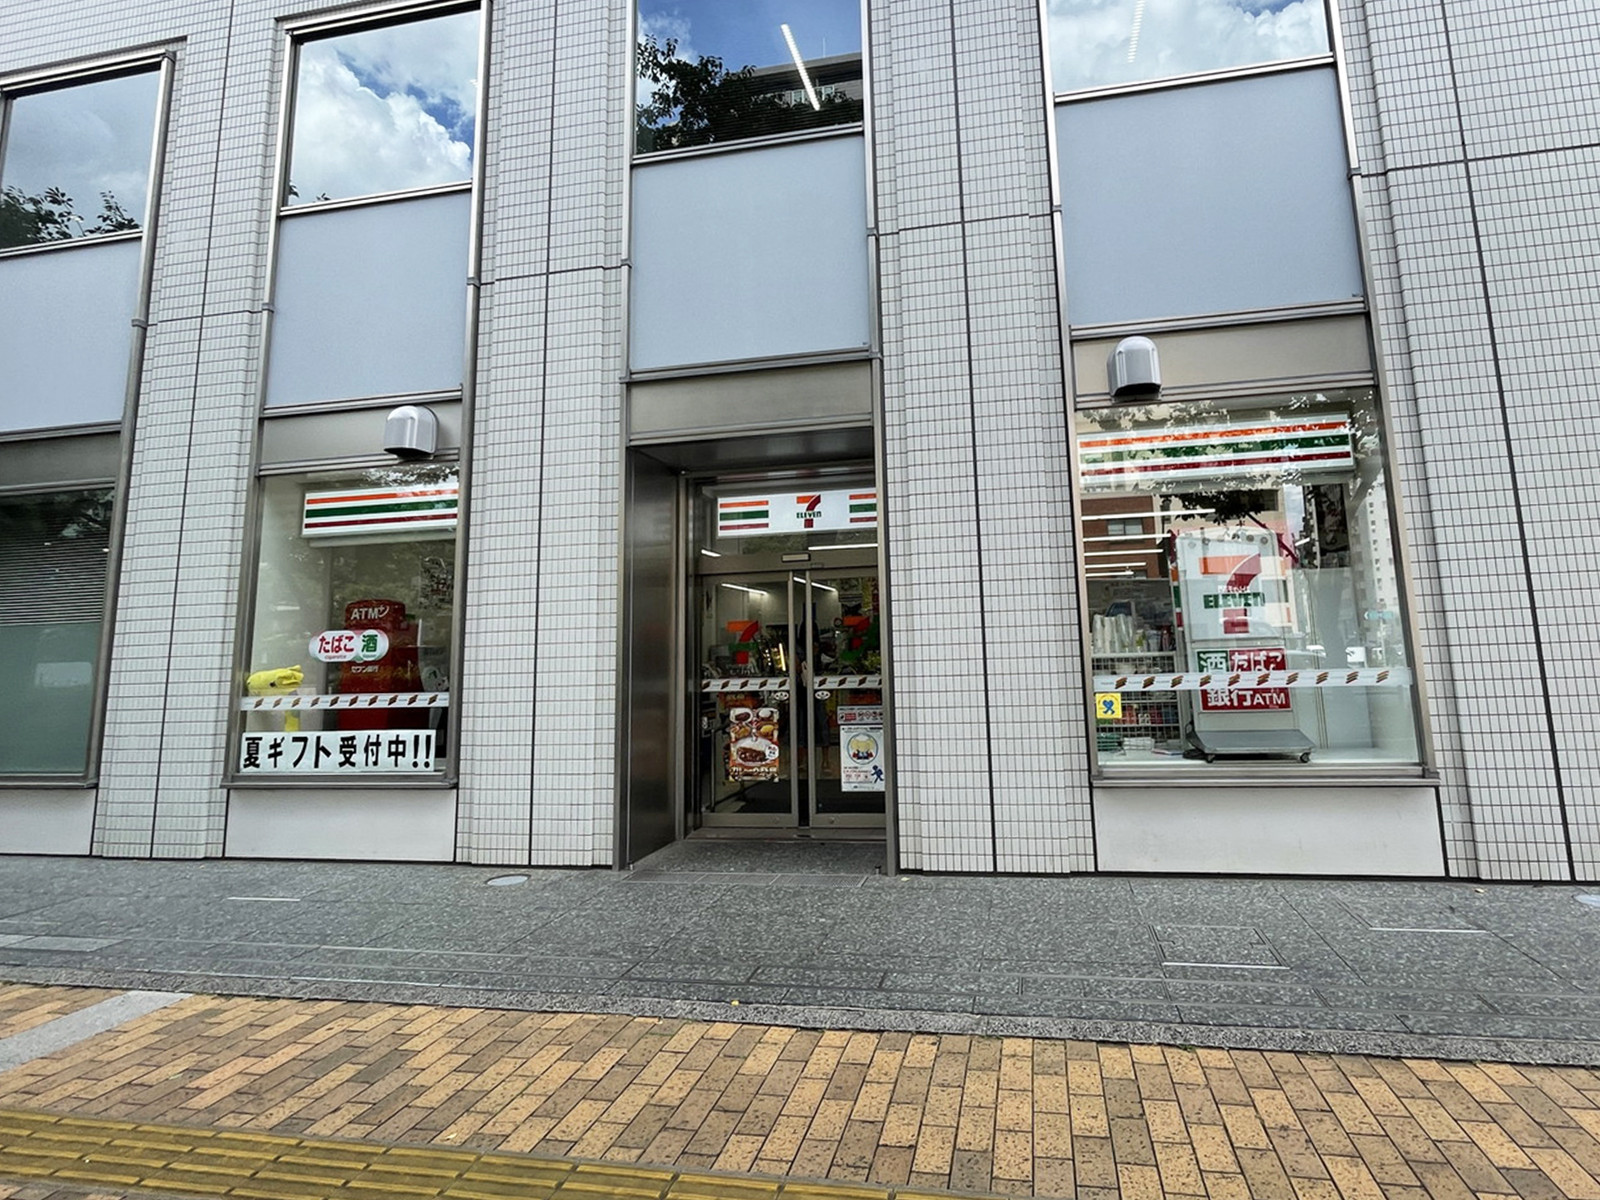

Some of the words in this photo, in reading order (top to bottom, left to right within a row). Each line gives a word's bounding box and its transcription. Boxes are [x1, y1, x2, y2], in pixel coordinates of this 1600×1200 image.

[796, 494, 822, 529] 7
[350, 607, 379, 620] ATM
[318, 634, 355, 654] たばこ
[361, 633, 379, 653] 酒
[1207, 687, 1286, 707] 銀行ATM
[243, 734, 432, 769] 夏ギフト受付中!!
